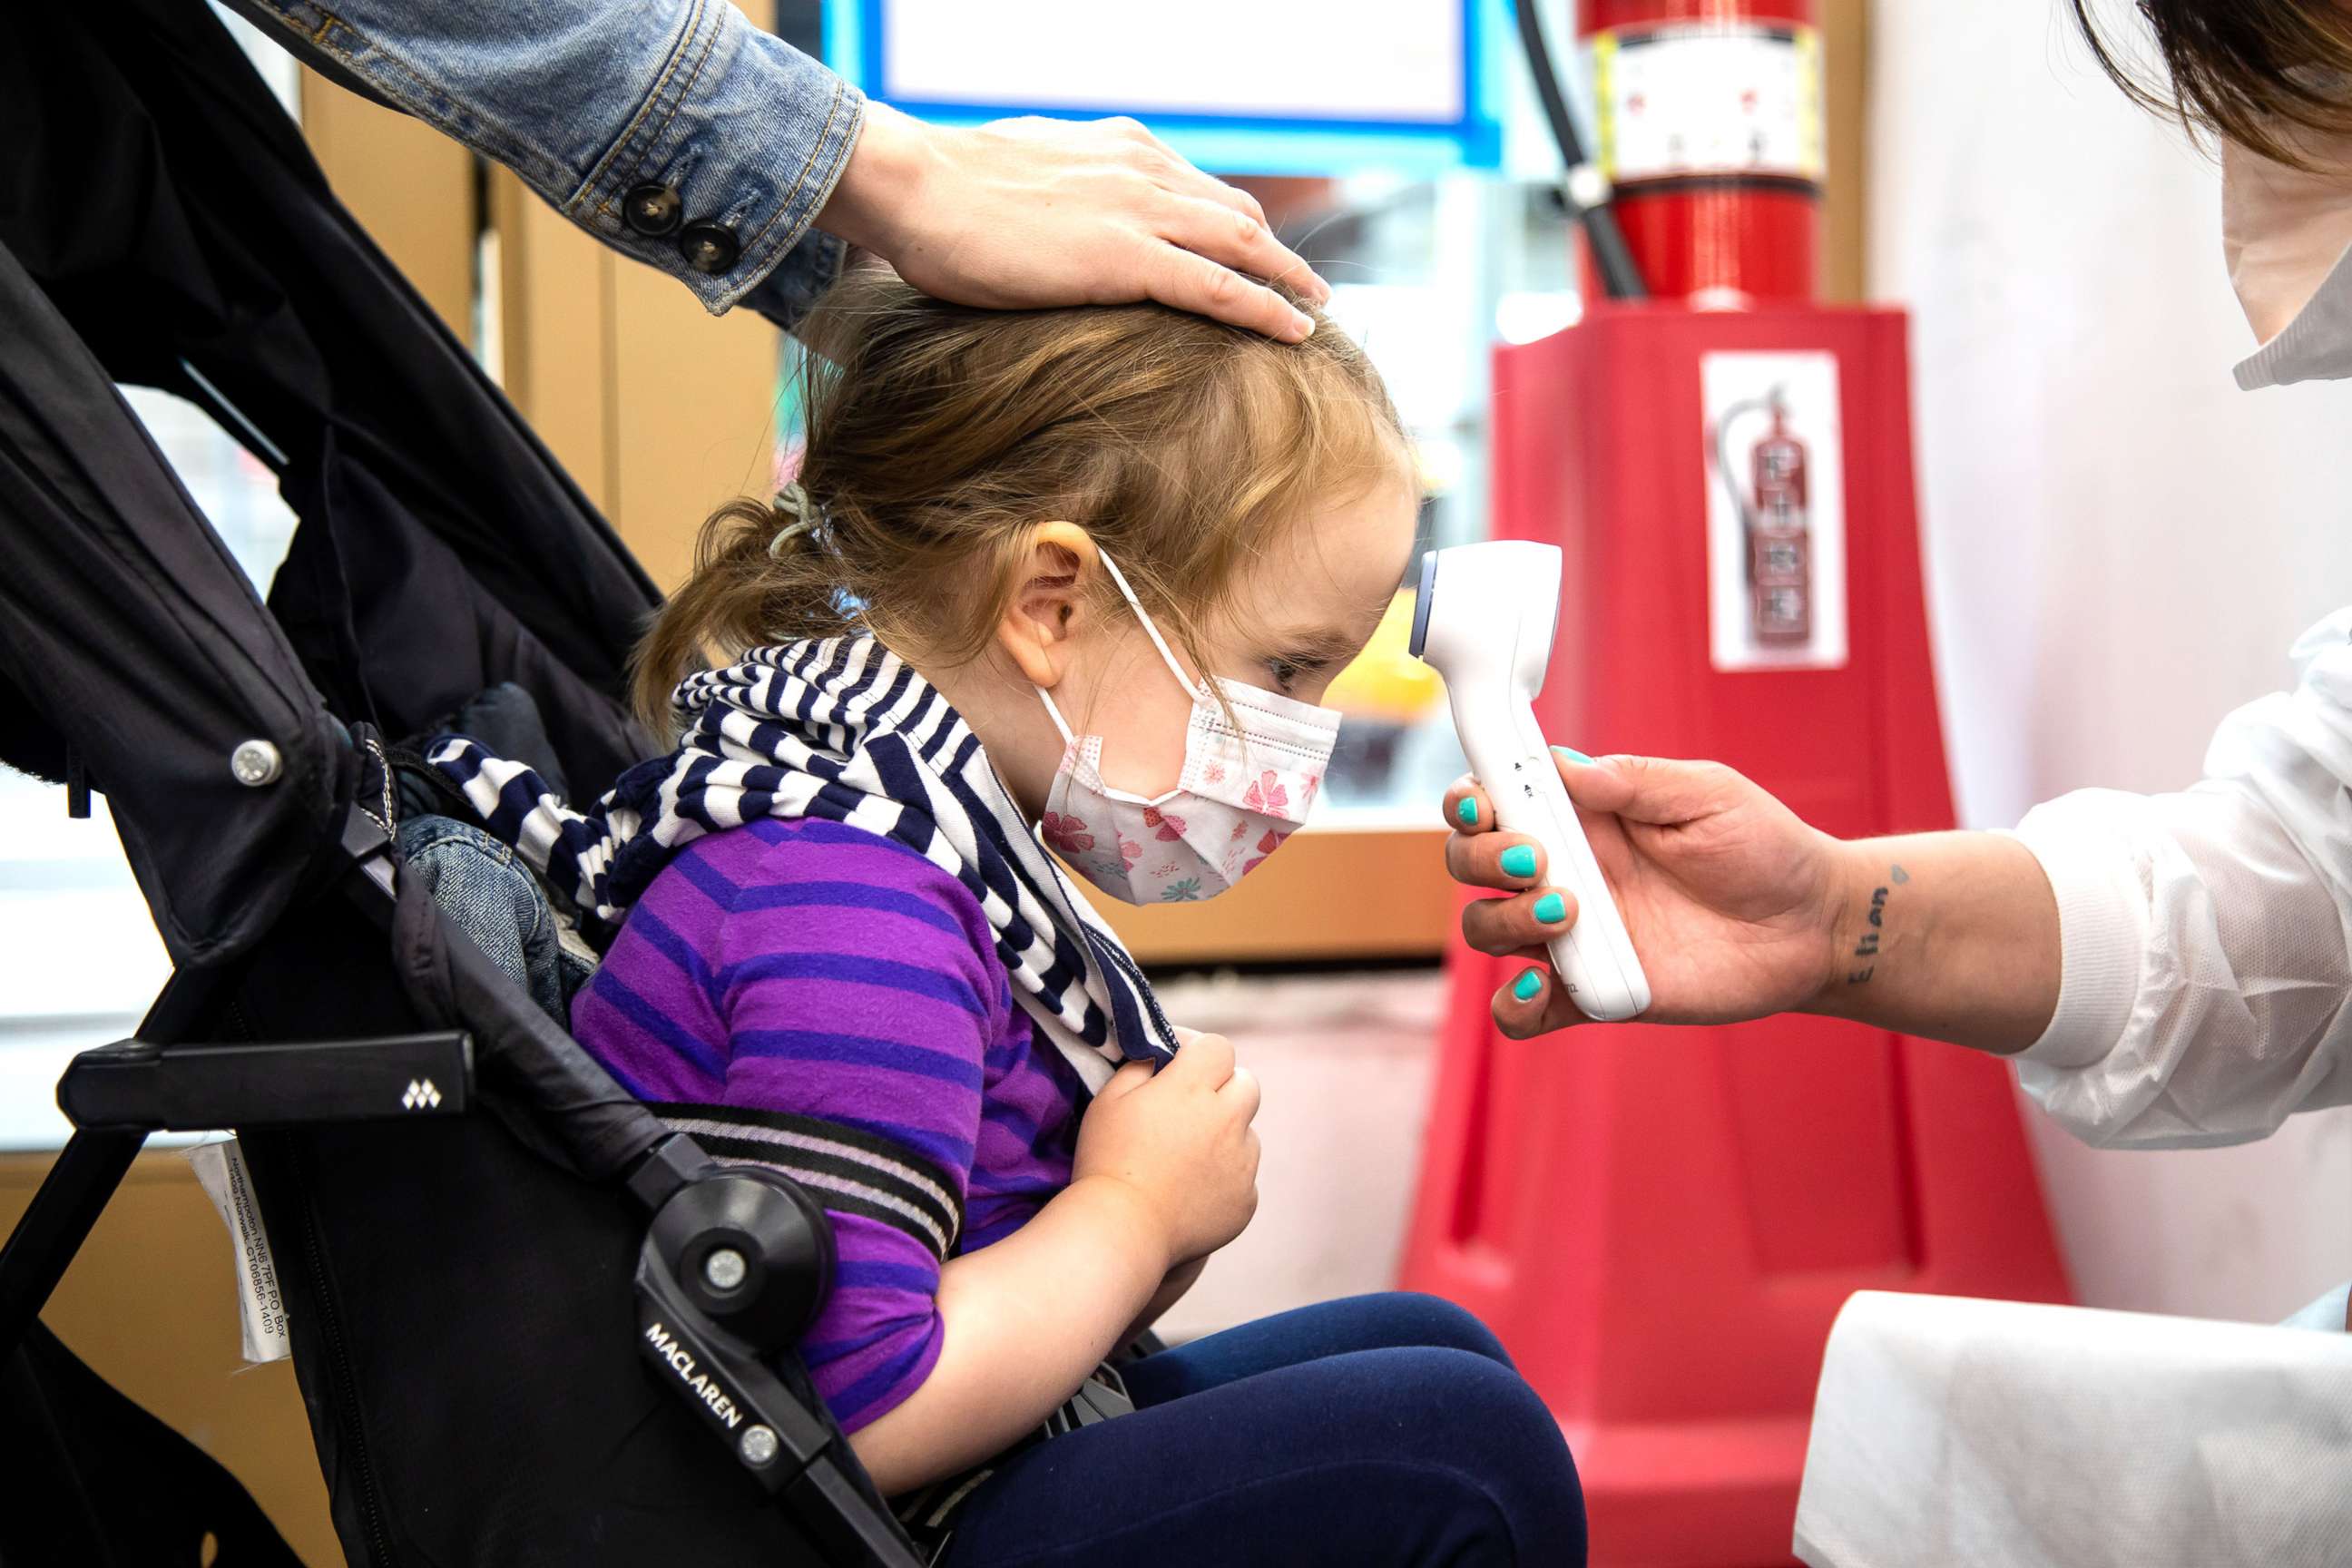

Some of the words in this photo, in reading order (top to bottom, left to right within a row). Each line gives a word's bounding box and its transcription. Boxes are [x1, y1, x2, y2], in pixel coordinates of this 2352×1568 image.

[253, 1237, 268, 1264] NN6
[261, 1265, 275, 1288] 7PF
[274, 1315, 286, 1338] Box
[645, 1322, 743, 1429] MACLAREN
